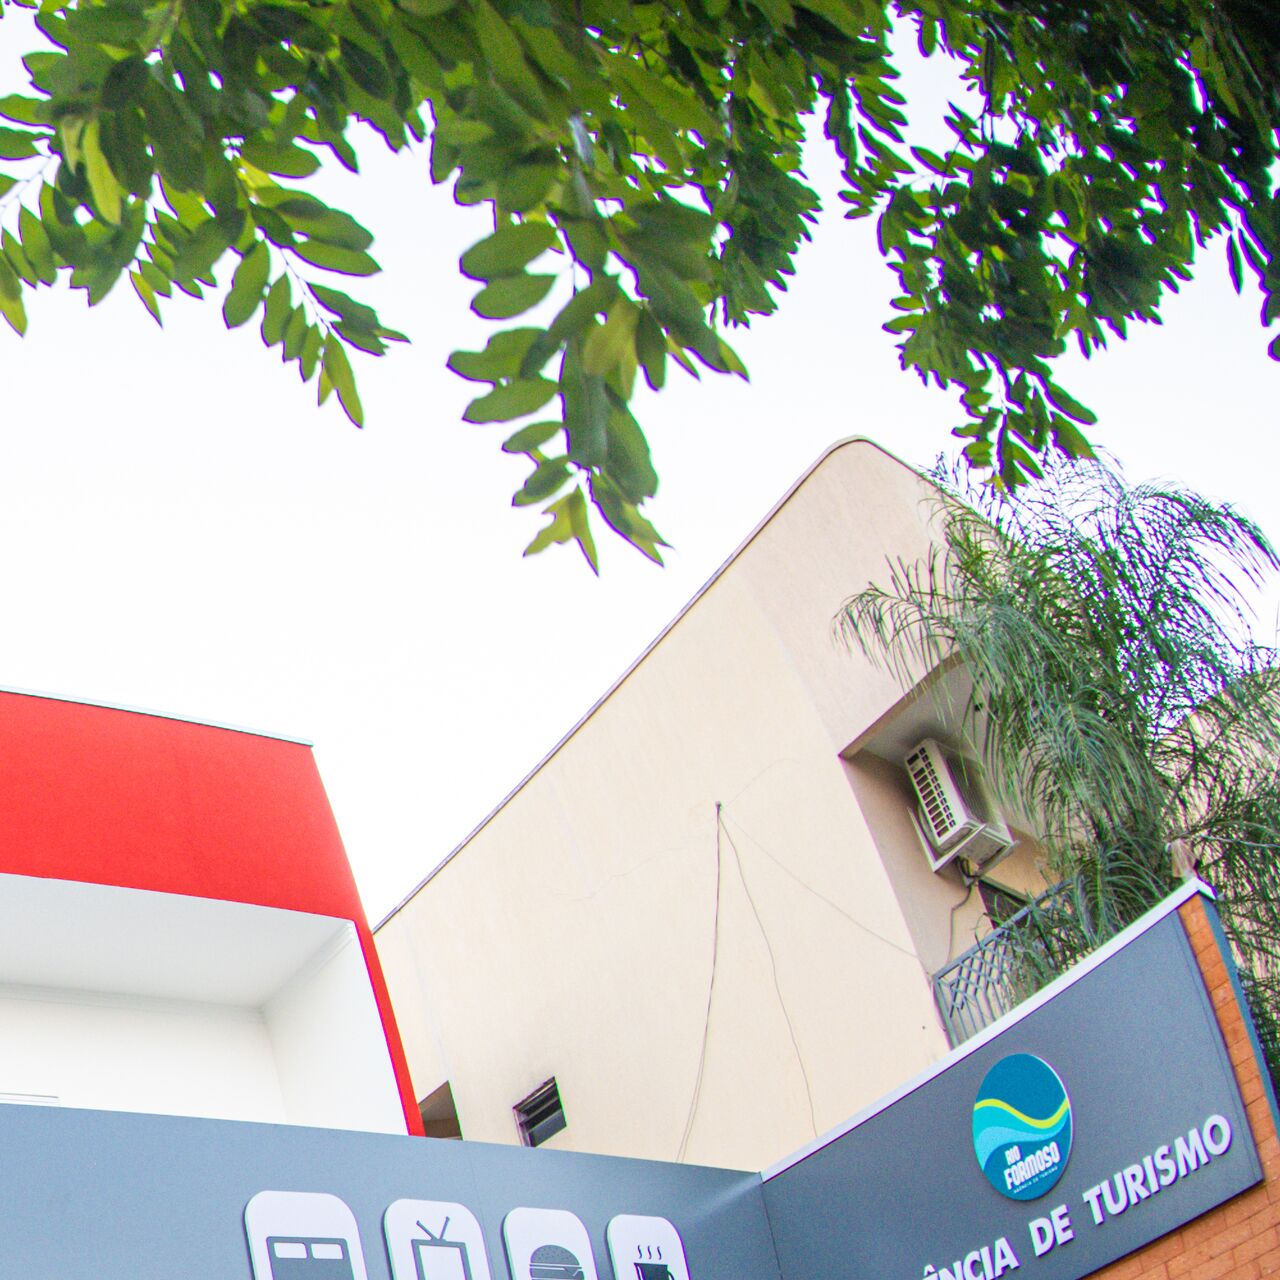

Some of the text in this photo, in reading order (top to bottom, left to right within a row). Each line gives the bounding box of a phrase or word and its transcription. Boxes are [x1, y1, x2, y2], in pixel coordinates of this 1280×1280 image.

[1003, 1141, 1061, 1190] FORMOSO
[1004, 1145, 1021, 1165] RIO
[1028, 1204, 1076, 1257] DE
[1082, 1114, 1233, 1225] TURISMO
